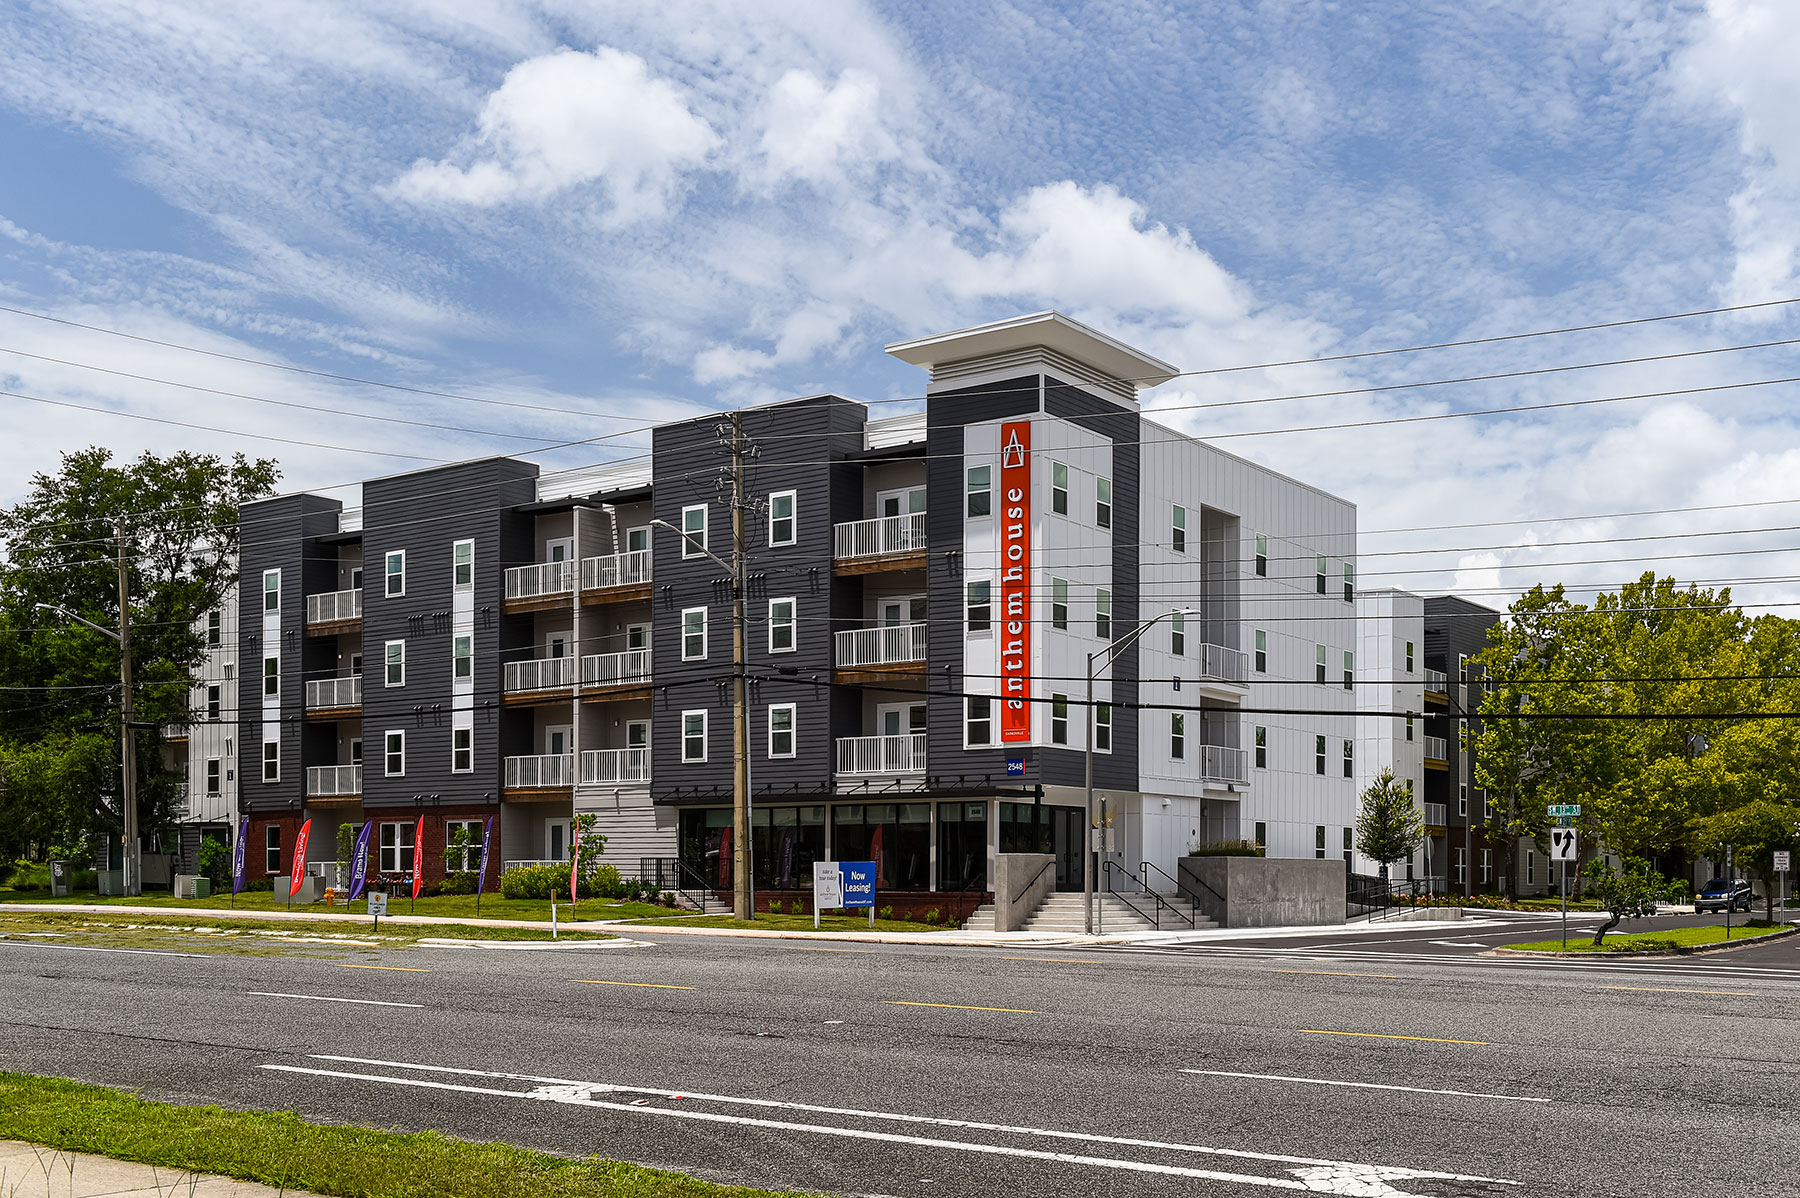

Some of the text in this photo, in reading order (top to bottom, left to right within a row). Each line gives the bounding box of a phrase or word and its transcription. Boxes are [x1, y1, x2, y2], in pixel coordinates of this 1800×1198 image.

[1002, 487, 1023, 710] anthem house
[1008, 762, 1024, 771] 2548
[851, 871, 866, 880] Now
[845, 882, 871, 894] Leasing!
